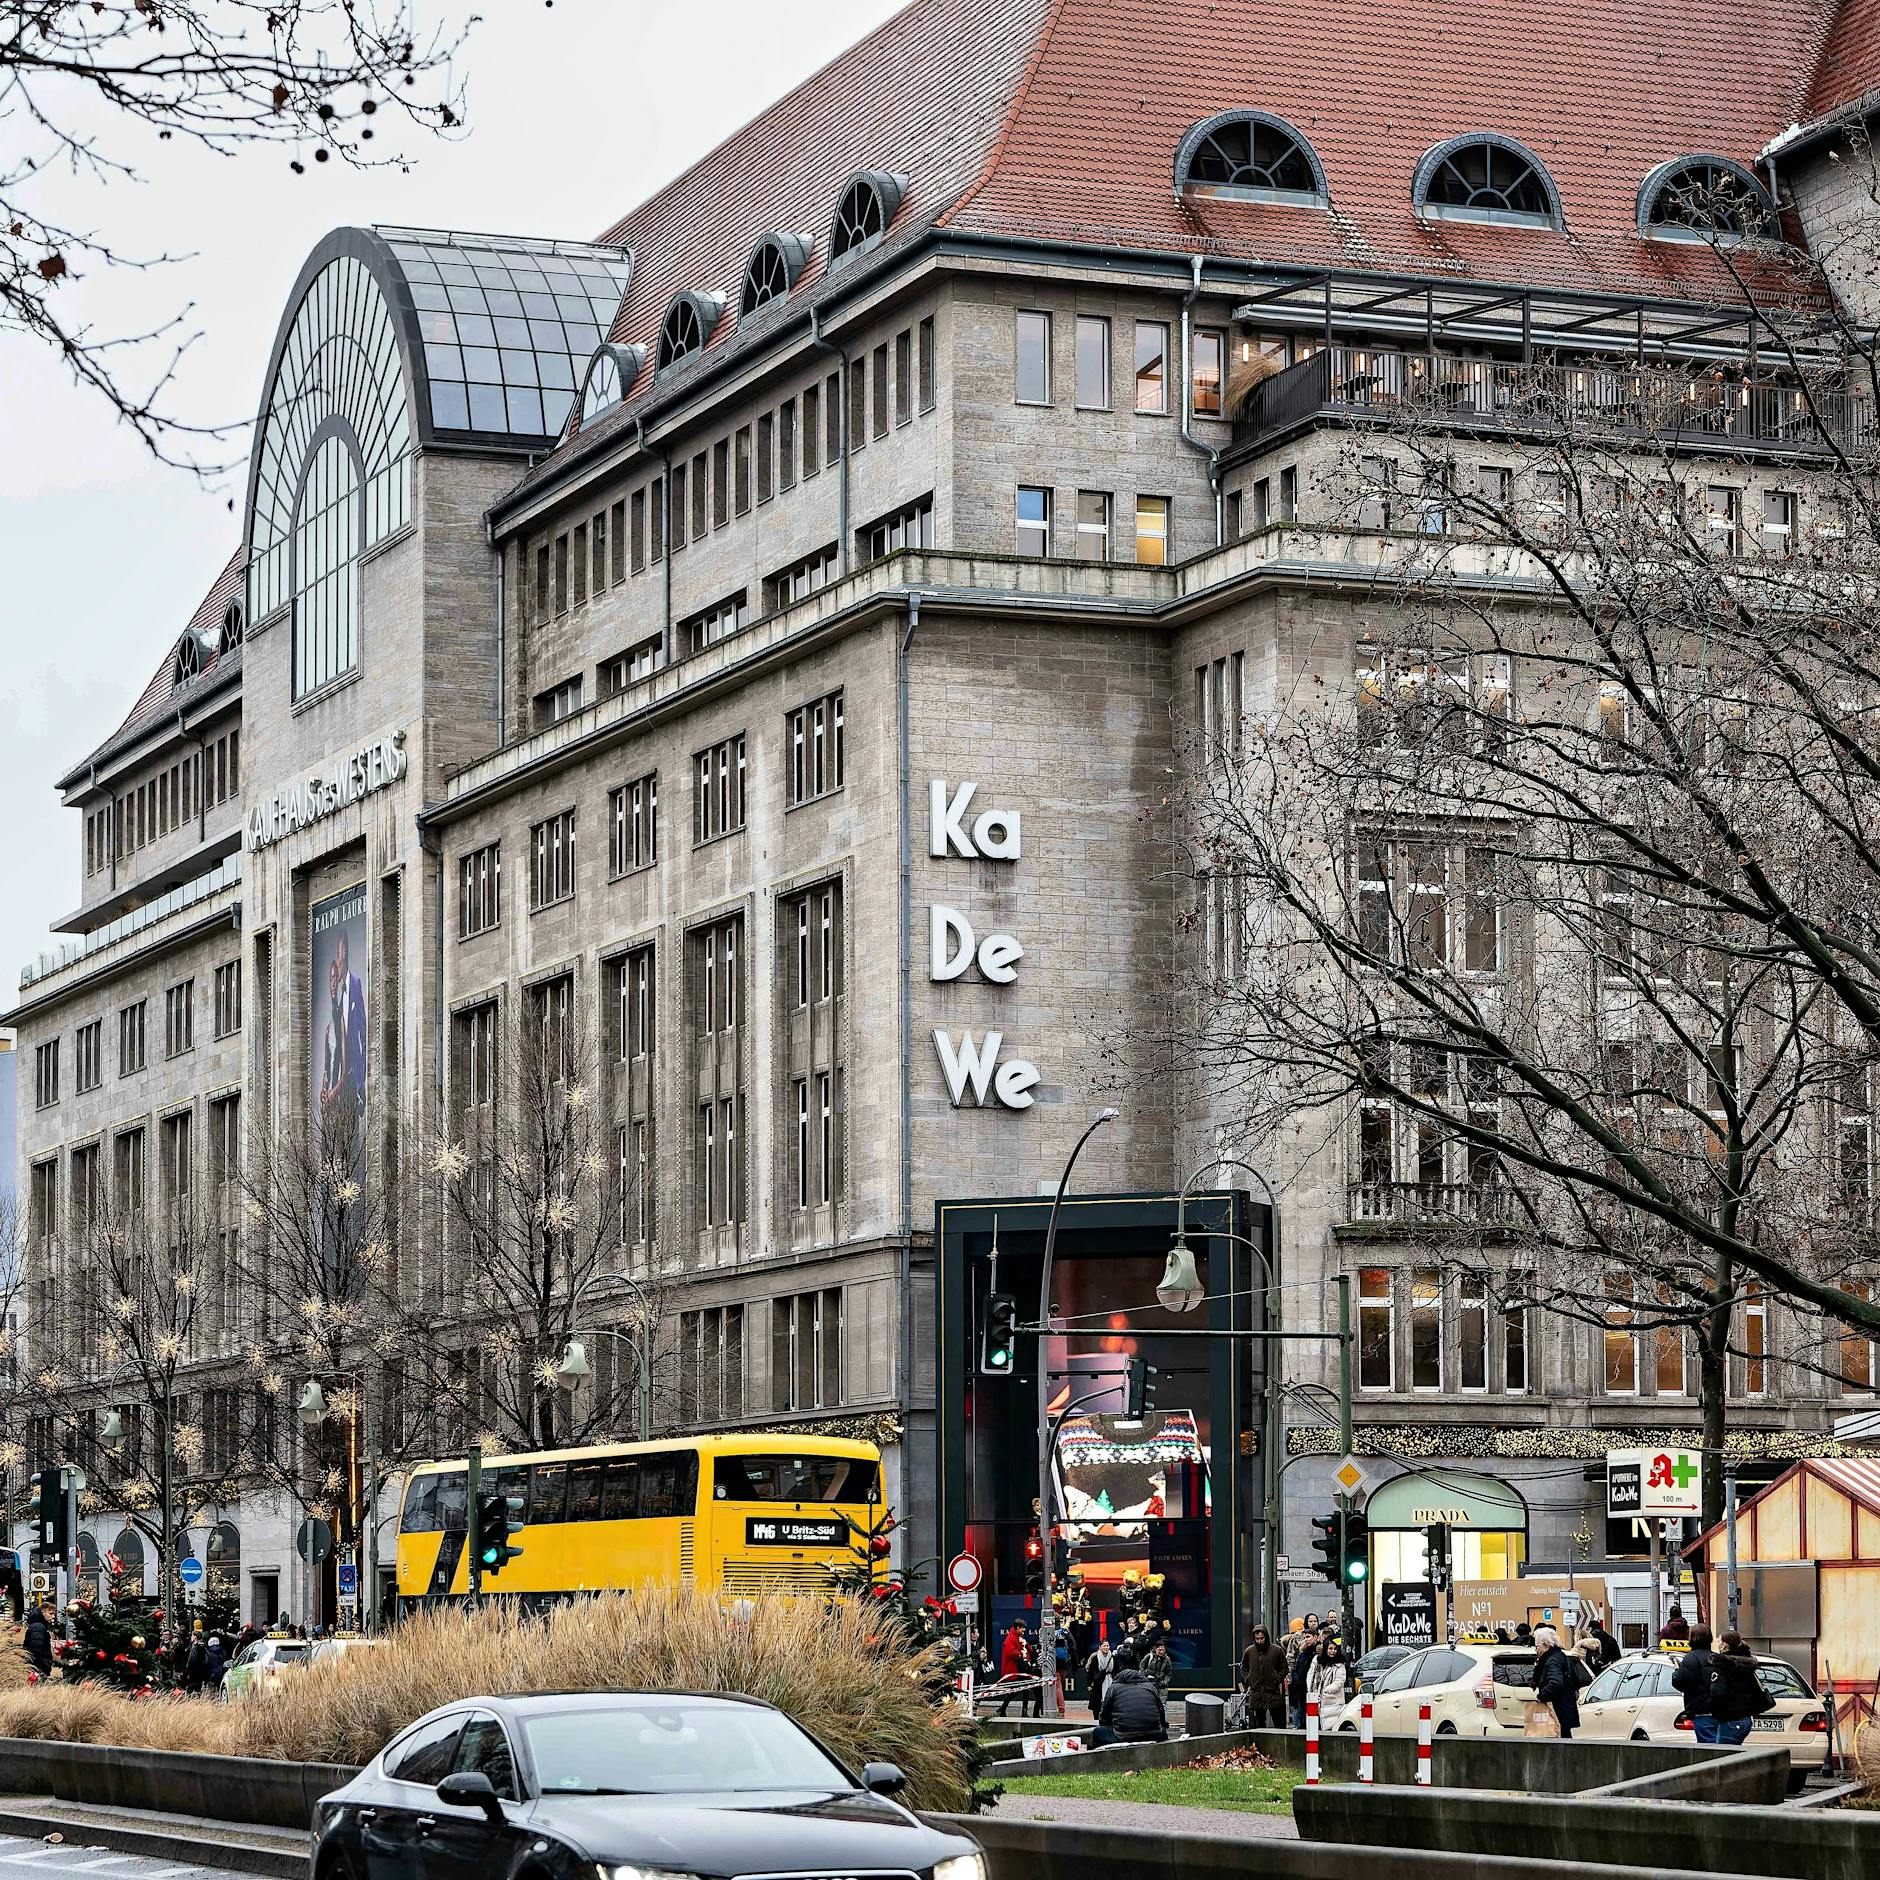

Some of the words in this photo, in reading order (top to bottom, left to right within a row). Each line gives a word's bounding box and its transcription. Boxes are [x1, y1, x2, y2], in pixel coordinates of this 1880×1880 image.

[246, 776, 322, 852] KAUFHAUS
[317, 781, 338, 816] DES
[335, 730, 407, 805] WESTENS
[930, 779, 1021, 861] Ka
[315, 908, 339, 933] RALPH
[342, 896, 367, 922] LAURE
[930, 904, 1025, 984] De
[932, 1030, 1041, 1108] We
[1612, 1473, 1632, 1484] APOTHEKE
[1611, 1486, 1638, 1502] KaDeWe
[1413, 1509, 1471, 1522] PRADA
[753, 1524, 776, 1539] M46
[782, 1525, 789, 1534] U
[792, 1525, 835, 1535] Britz-Süd
[1460, 1585, 1476, 1597] Hier
[1477, 1586, 1508, 1597] entsteht
[1387, 1613, 1432, 1634] KaDeWe
[1388, 1636, 1399, 1644] DIE
[1401, 1635, 1433, 1644] SECHSTE
[1763, 1720, 1783, 1729] 5298
